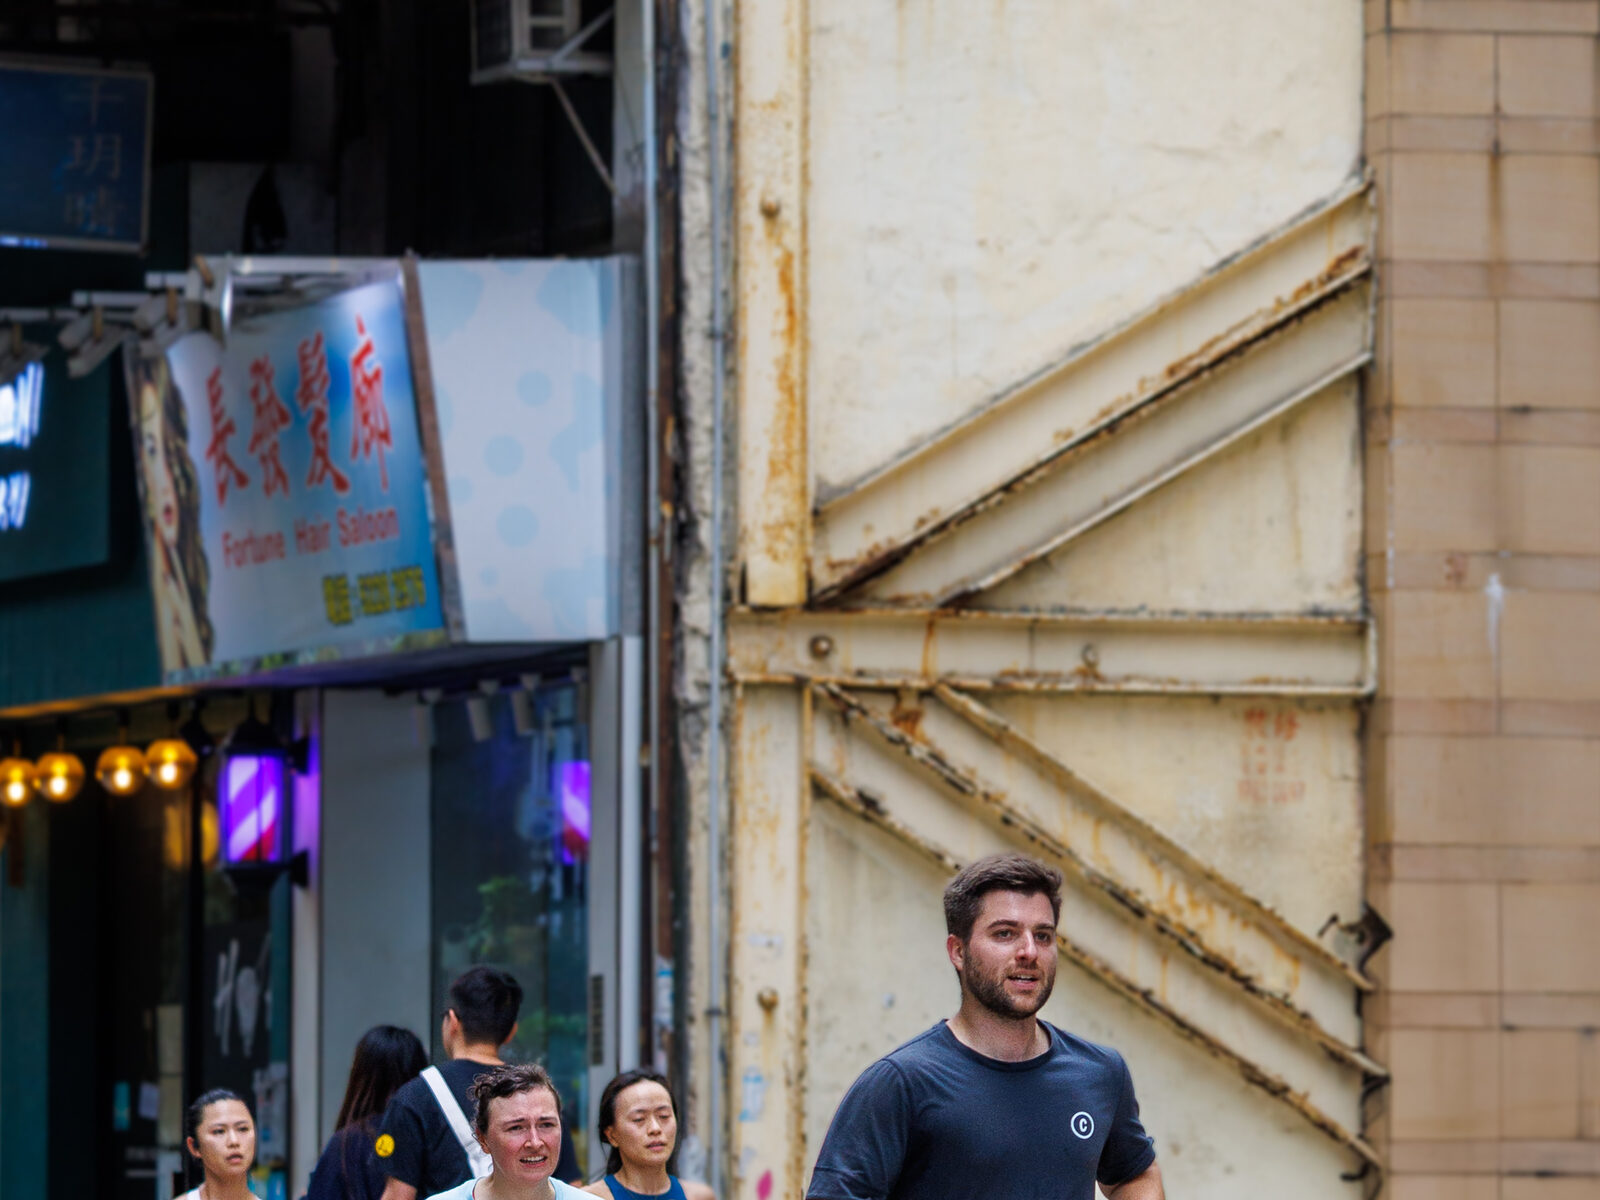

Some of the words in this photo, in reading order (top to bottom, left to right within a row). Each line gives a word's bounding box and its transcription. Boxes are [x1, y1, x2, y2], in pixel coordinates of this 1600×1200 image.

[221, 529, 286, 568] Fortune
[294, 511, 331, 554] Hair
[336, 504, 399, 547] Saloon
